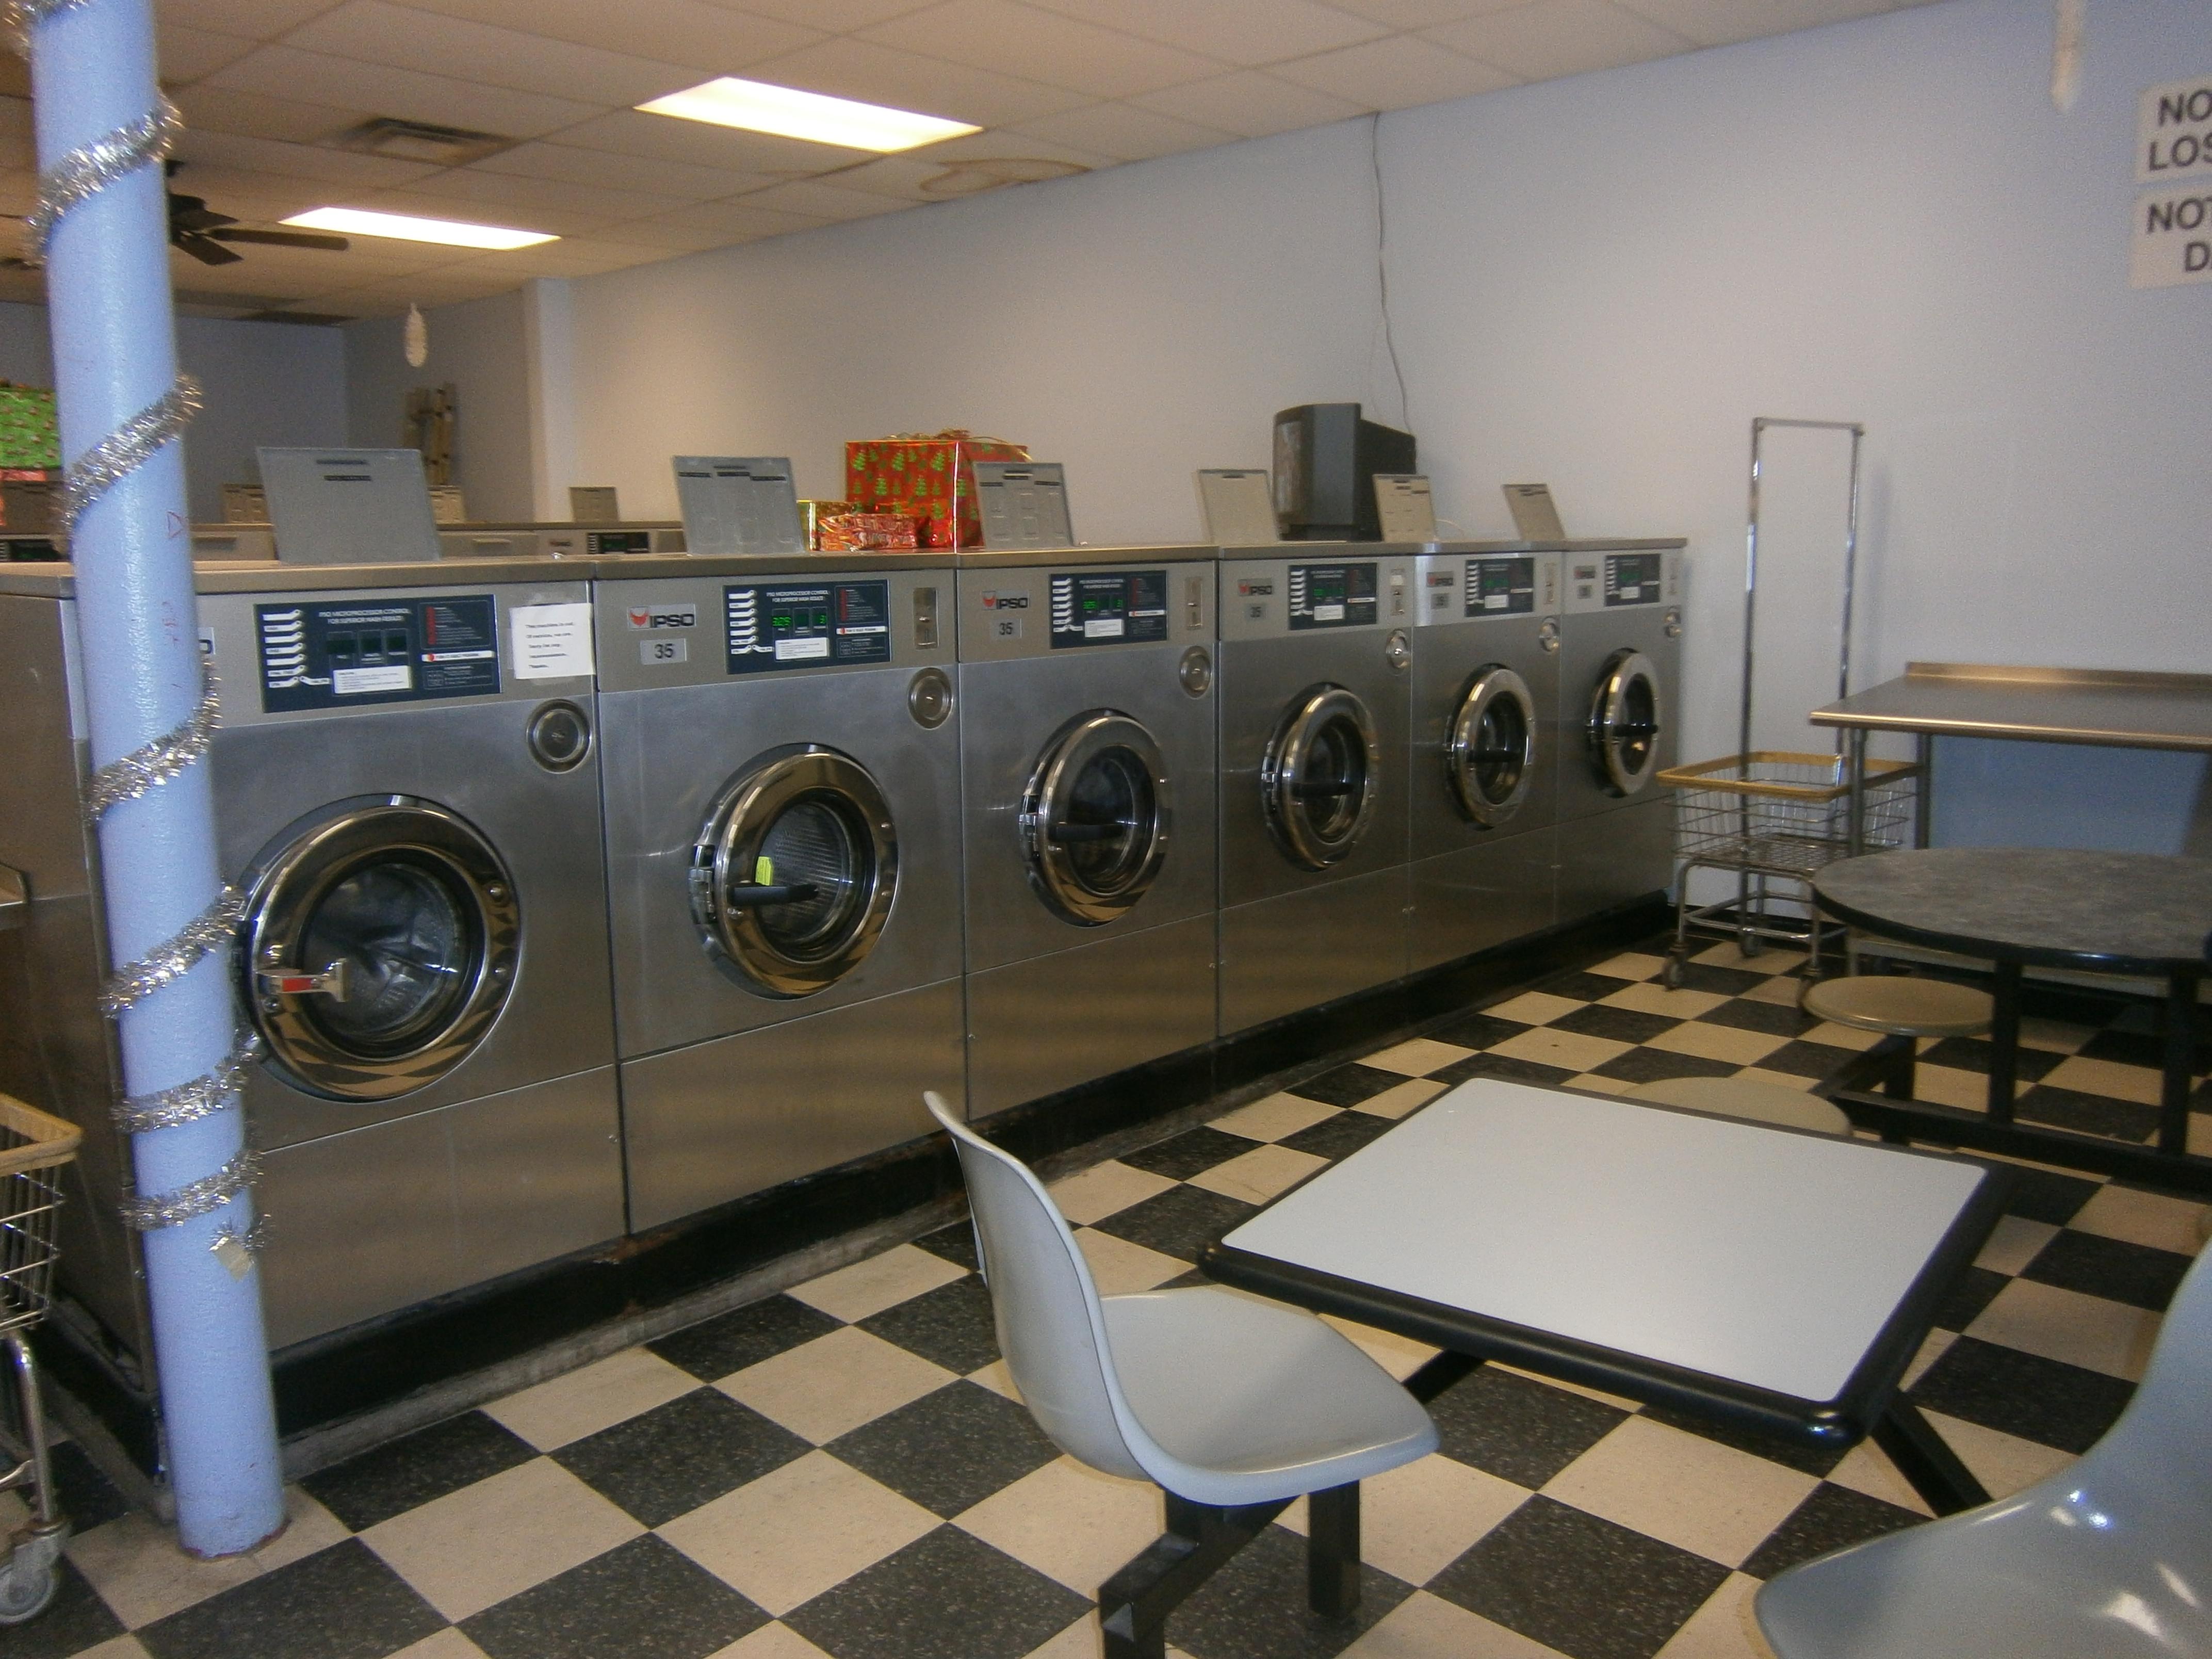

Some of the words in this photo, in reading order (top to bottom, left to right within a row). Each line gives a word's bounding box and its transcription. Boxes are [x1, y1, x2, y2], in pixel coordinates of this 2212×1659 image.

[997, 597, 1028, 609] IPSO
[649, 613, 694, 628] IPSO
[999, 622, 1013, 635] 35
[655, 643, 674, 659] 35
